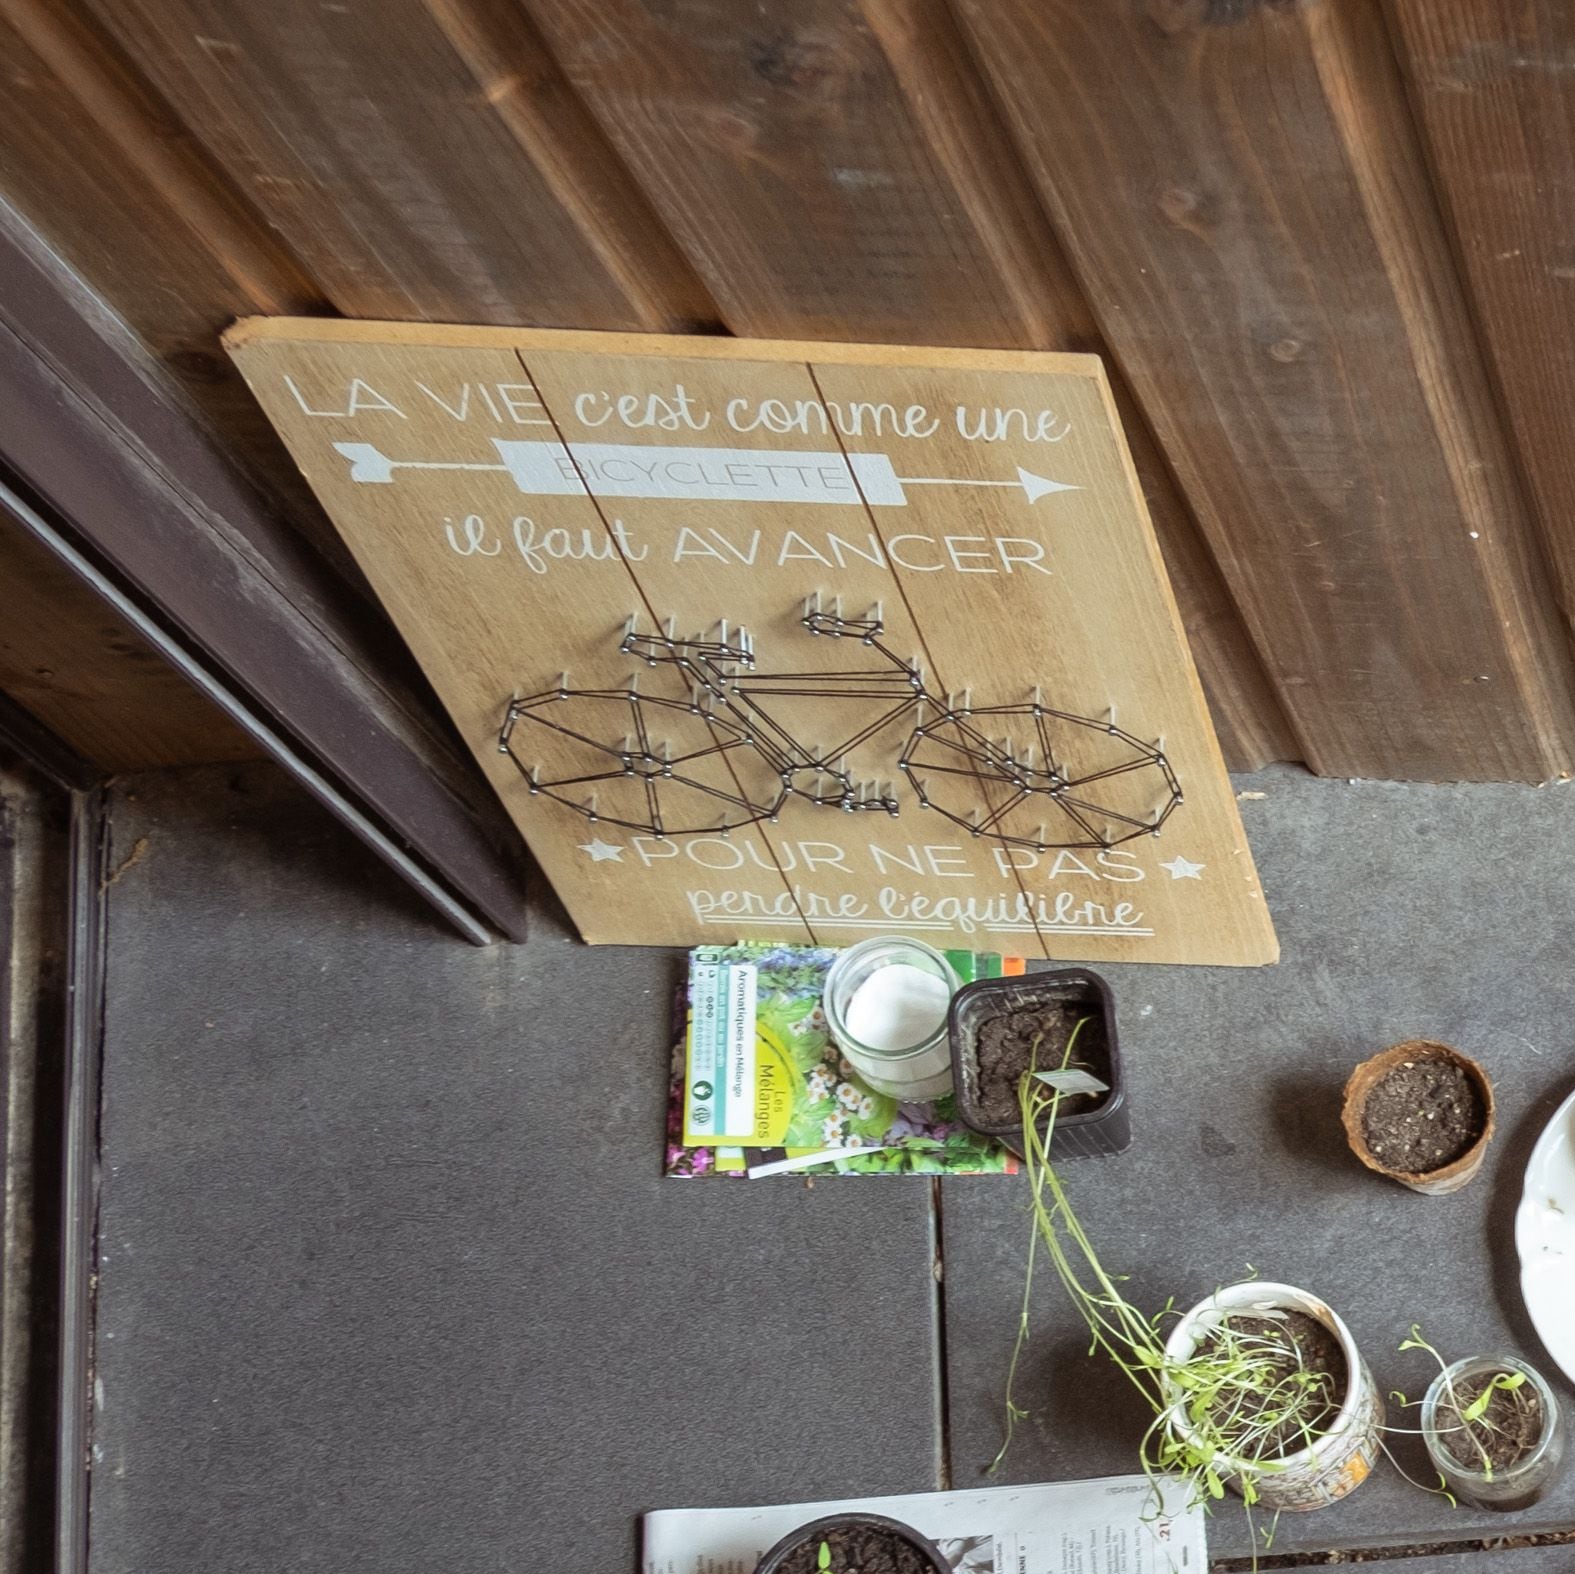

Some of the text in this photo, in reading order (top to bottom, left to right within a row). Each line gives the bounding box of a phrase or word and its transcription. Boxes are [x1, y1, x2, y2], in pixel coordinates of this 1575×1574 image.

[283, 372, 1071, 445] LA VIE c'est comme une
[554, 454, 852, 496] BICYCLETTE
[445, 514, 1053, 576] il faut AVANCER
[634, 837, 1146, 884] POUR NE PAS
[687, 884, 1146, 934] perdre l'équilibre
[732, 970, 749, 1098] Aromatiques en Mélange
[755, 1064, 776, 1139] Mélanges
[774, 1091, 787, 1113] Les
